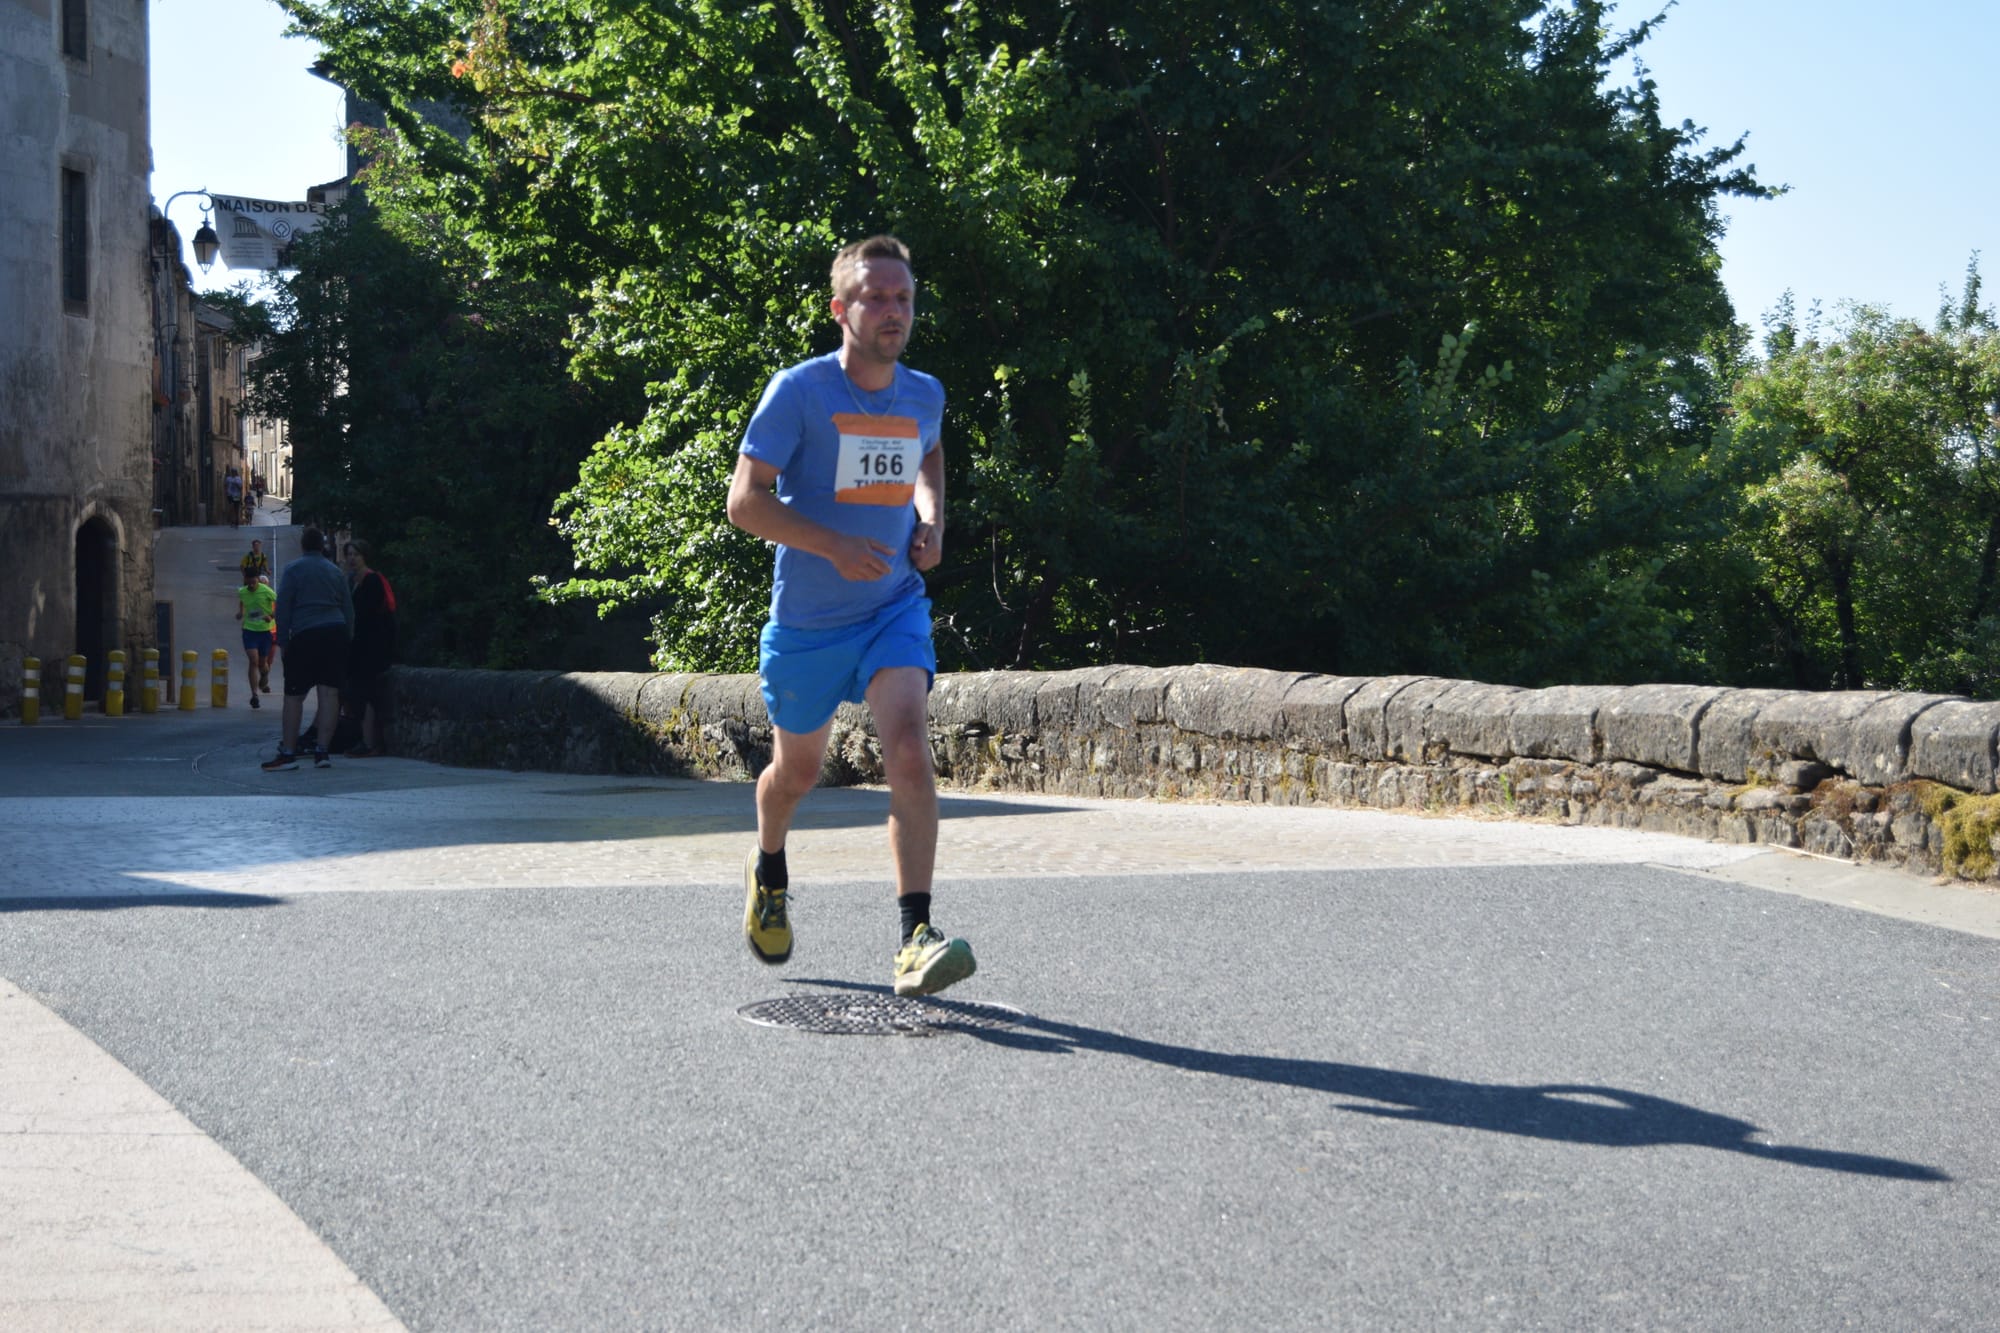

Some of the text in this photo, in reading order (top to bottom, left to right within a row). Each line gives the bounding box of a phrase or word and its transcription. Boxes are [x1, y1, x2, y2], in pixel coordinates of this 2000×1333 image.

[218, 199, 290, 213] MAISON
[295, 203, 318, 213] DE
[859, 453, 903, 476] 166
